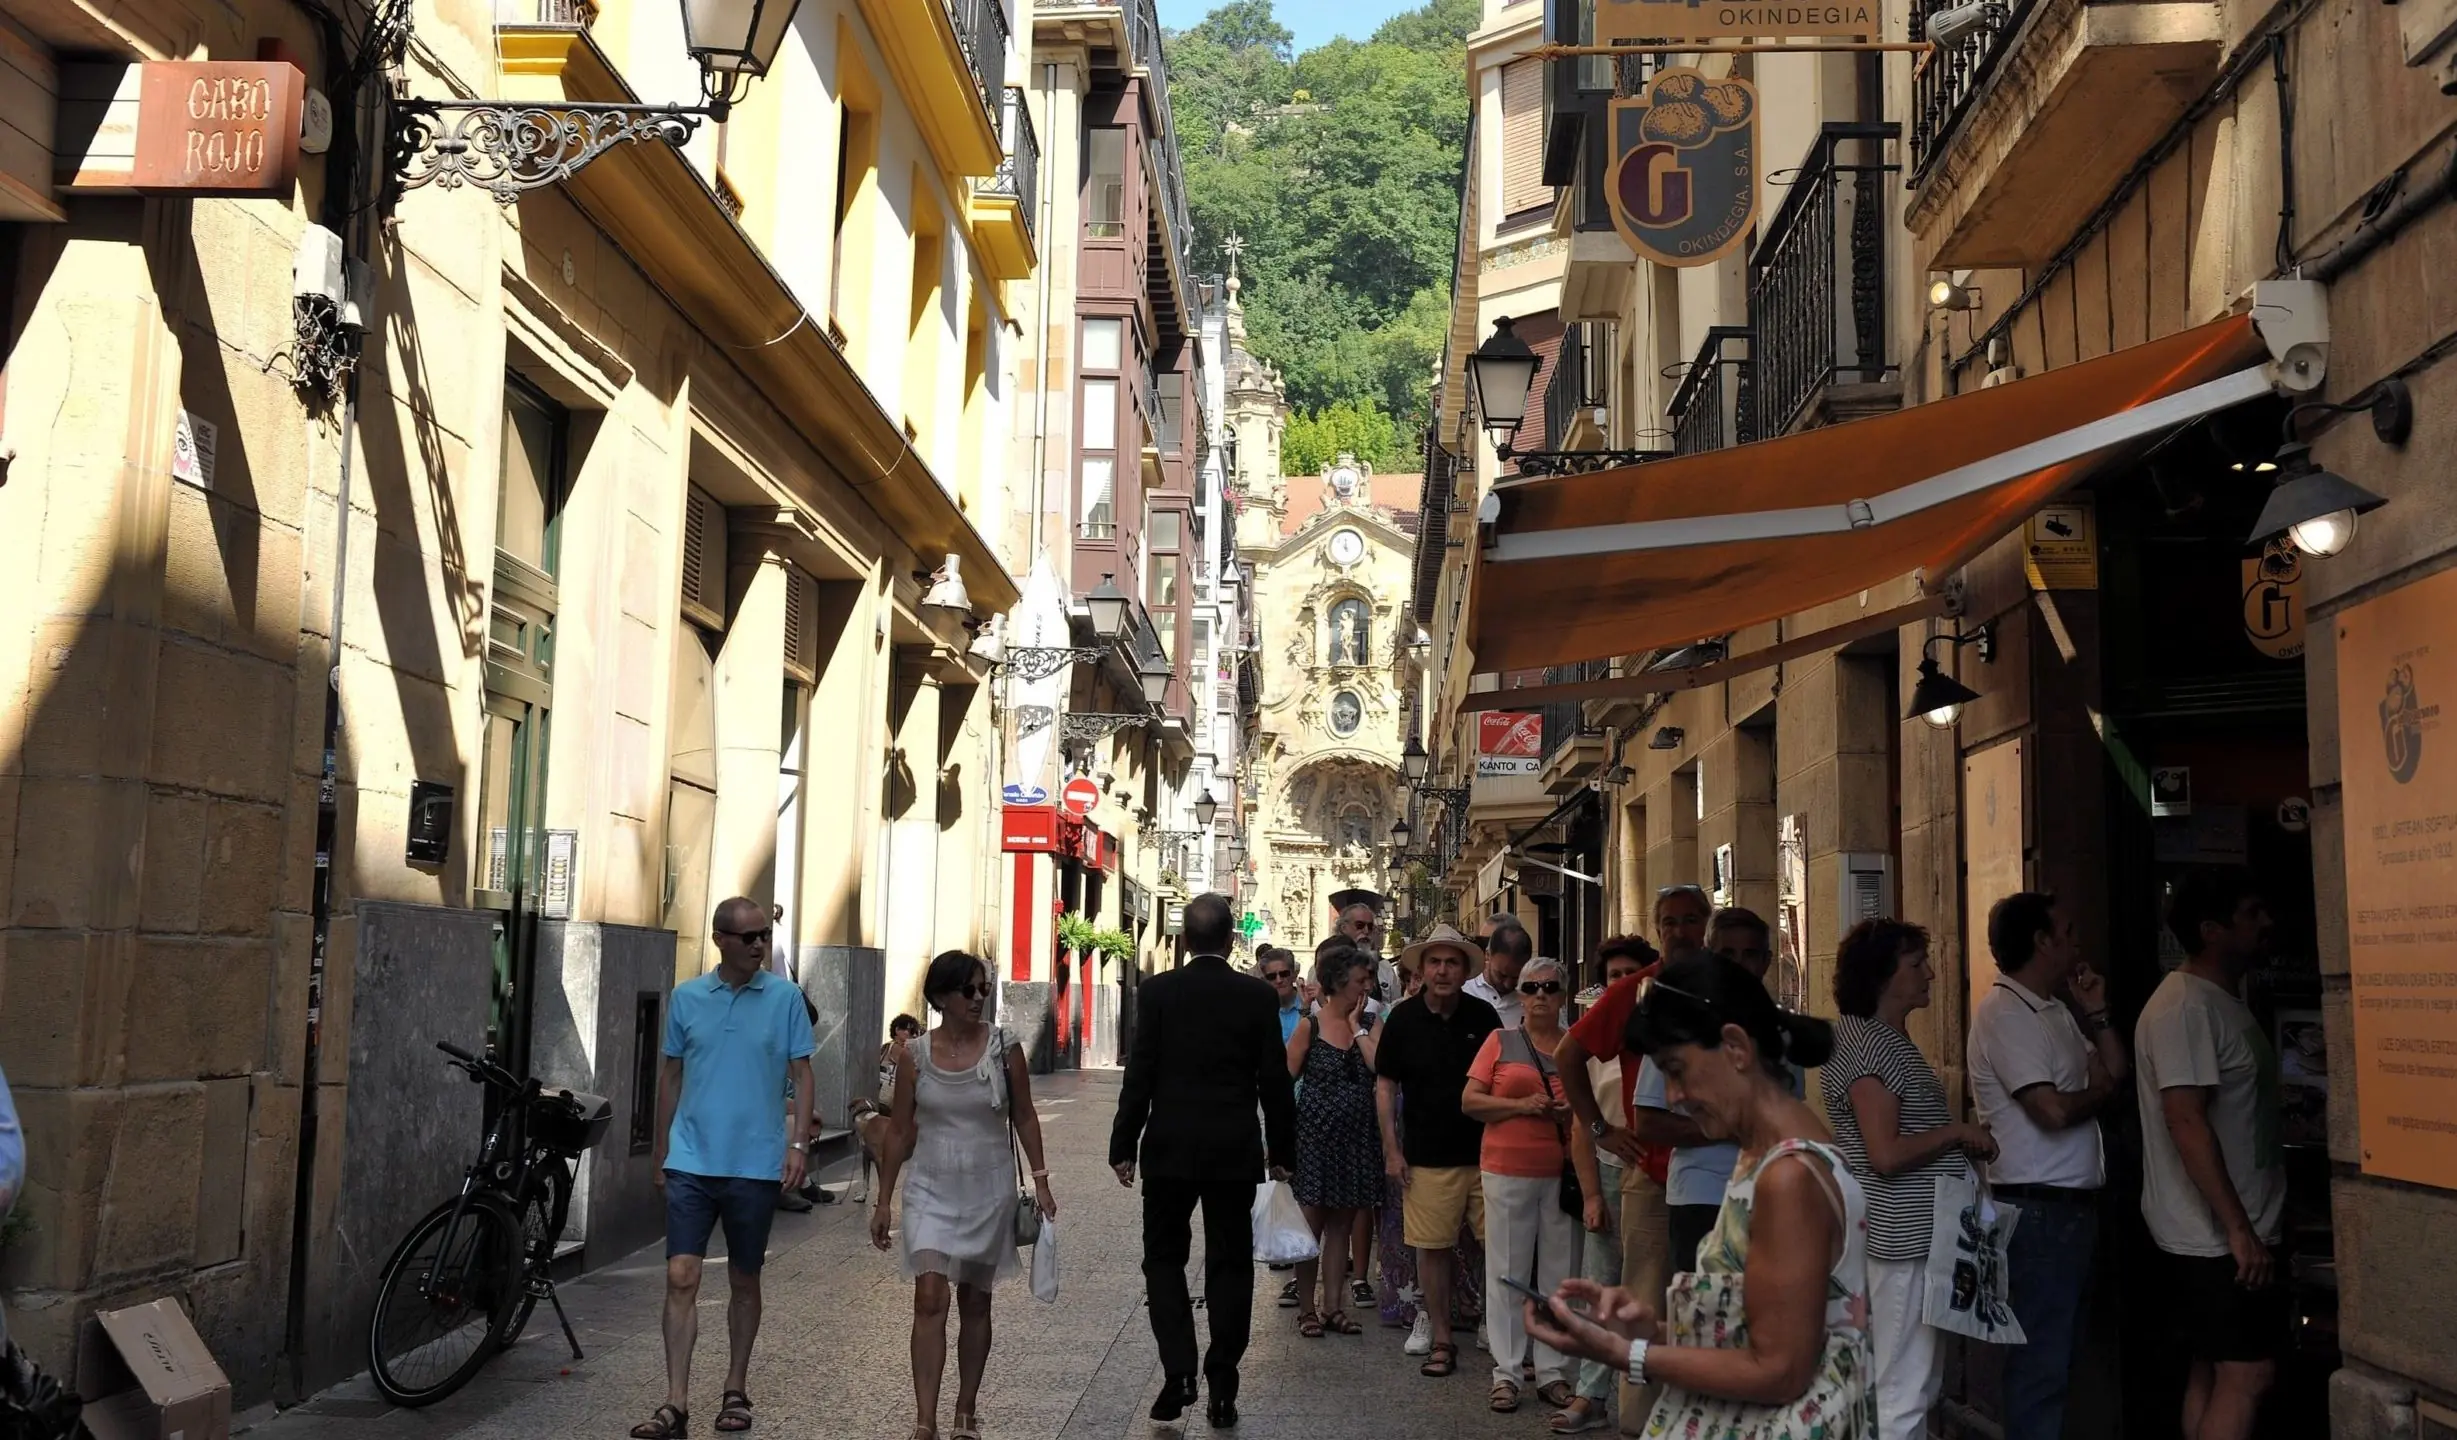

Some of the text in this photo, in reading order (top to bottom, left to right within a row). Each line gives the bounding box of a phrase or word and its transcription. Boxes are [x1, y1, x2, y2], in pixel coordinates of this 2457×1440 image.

[1719, 7, 1869, 26] OKINDEGIA
[187, 76, 271, 121] CABO
[184, 128, 264, 172] ROJO
[1734, 142, 1749, 177] S.A.
[1617, 141, 1692, 229] G
[2244, 580, 2291, 640] G
[1479, 761, 1517, 771] KANTOI
